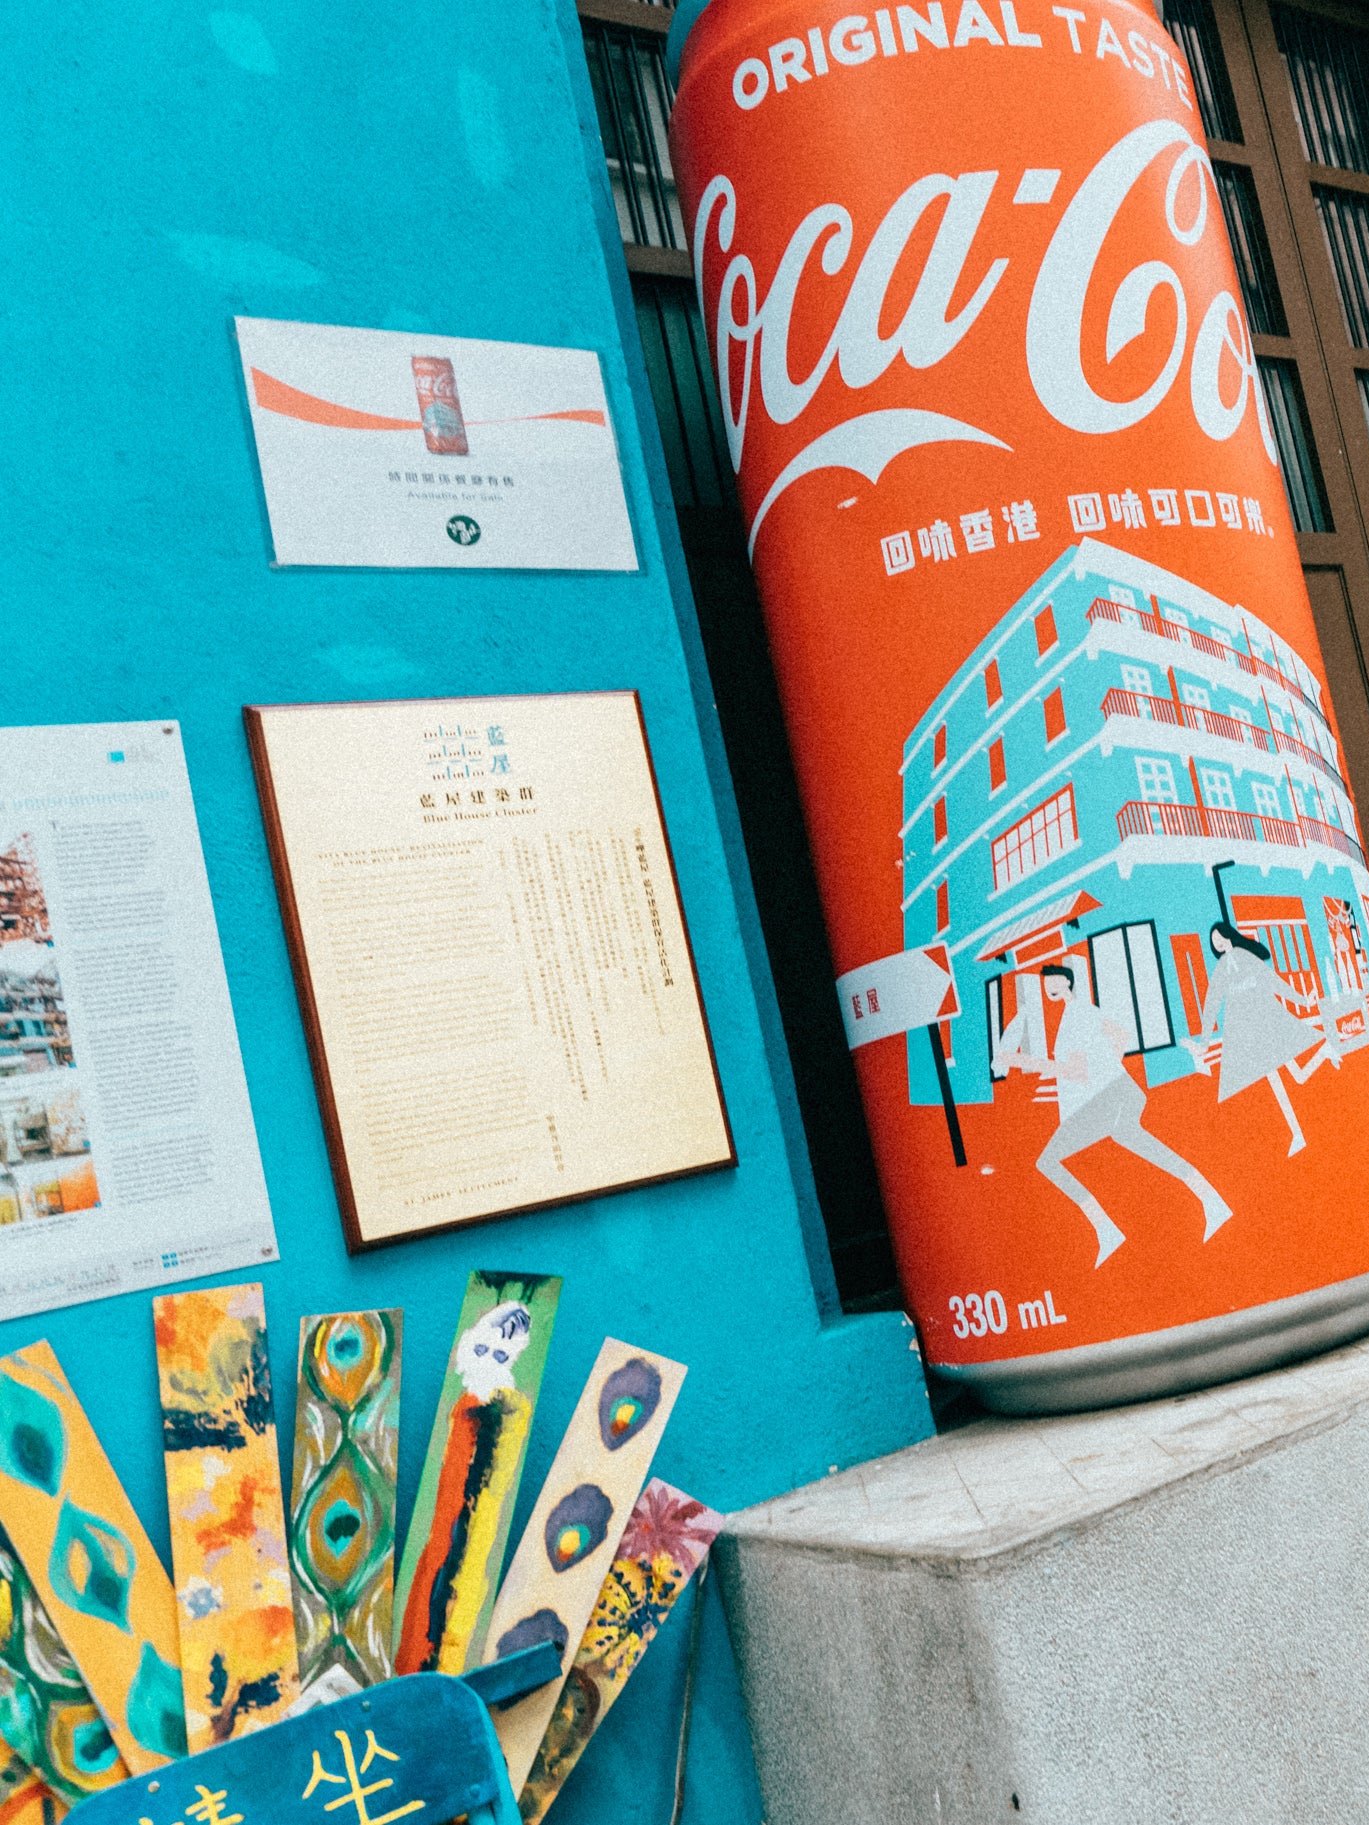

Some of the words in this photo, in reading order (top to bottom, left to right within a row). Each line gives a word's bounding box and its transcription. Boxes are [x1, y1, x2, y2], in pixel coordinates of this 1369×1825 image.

[732, 0, 1042, 110] ORIGINAL
[1052, 5, 1194, 110] TASTE
[693, 119, 1278, 475] Coca-Co
[880, 500, 1040, 576] 回味香港
[949, 1289, 1008, 1339] 330
[1017, 1290, 1068, 1330] mL
